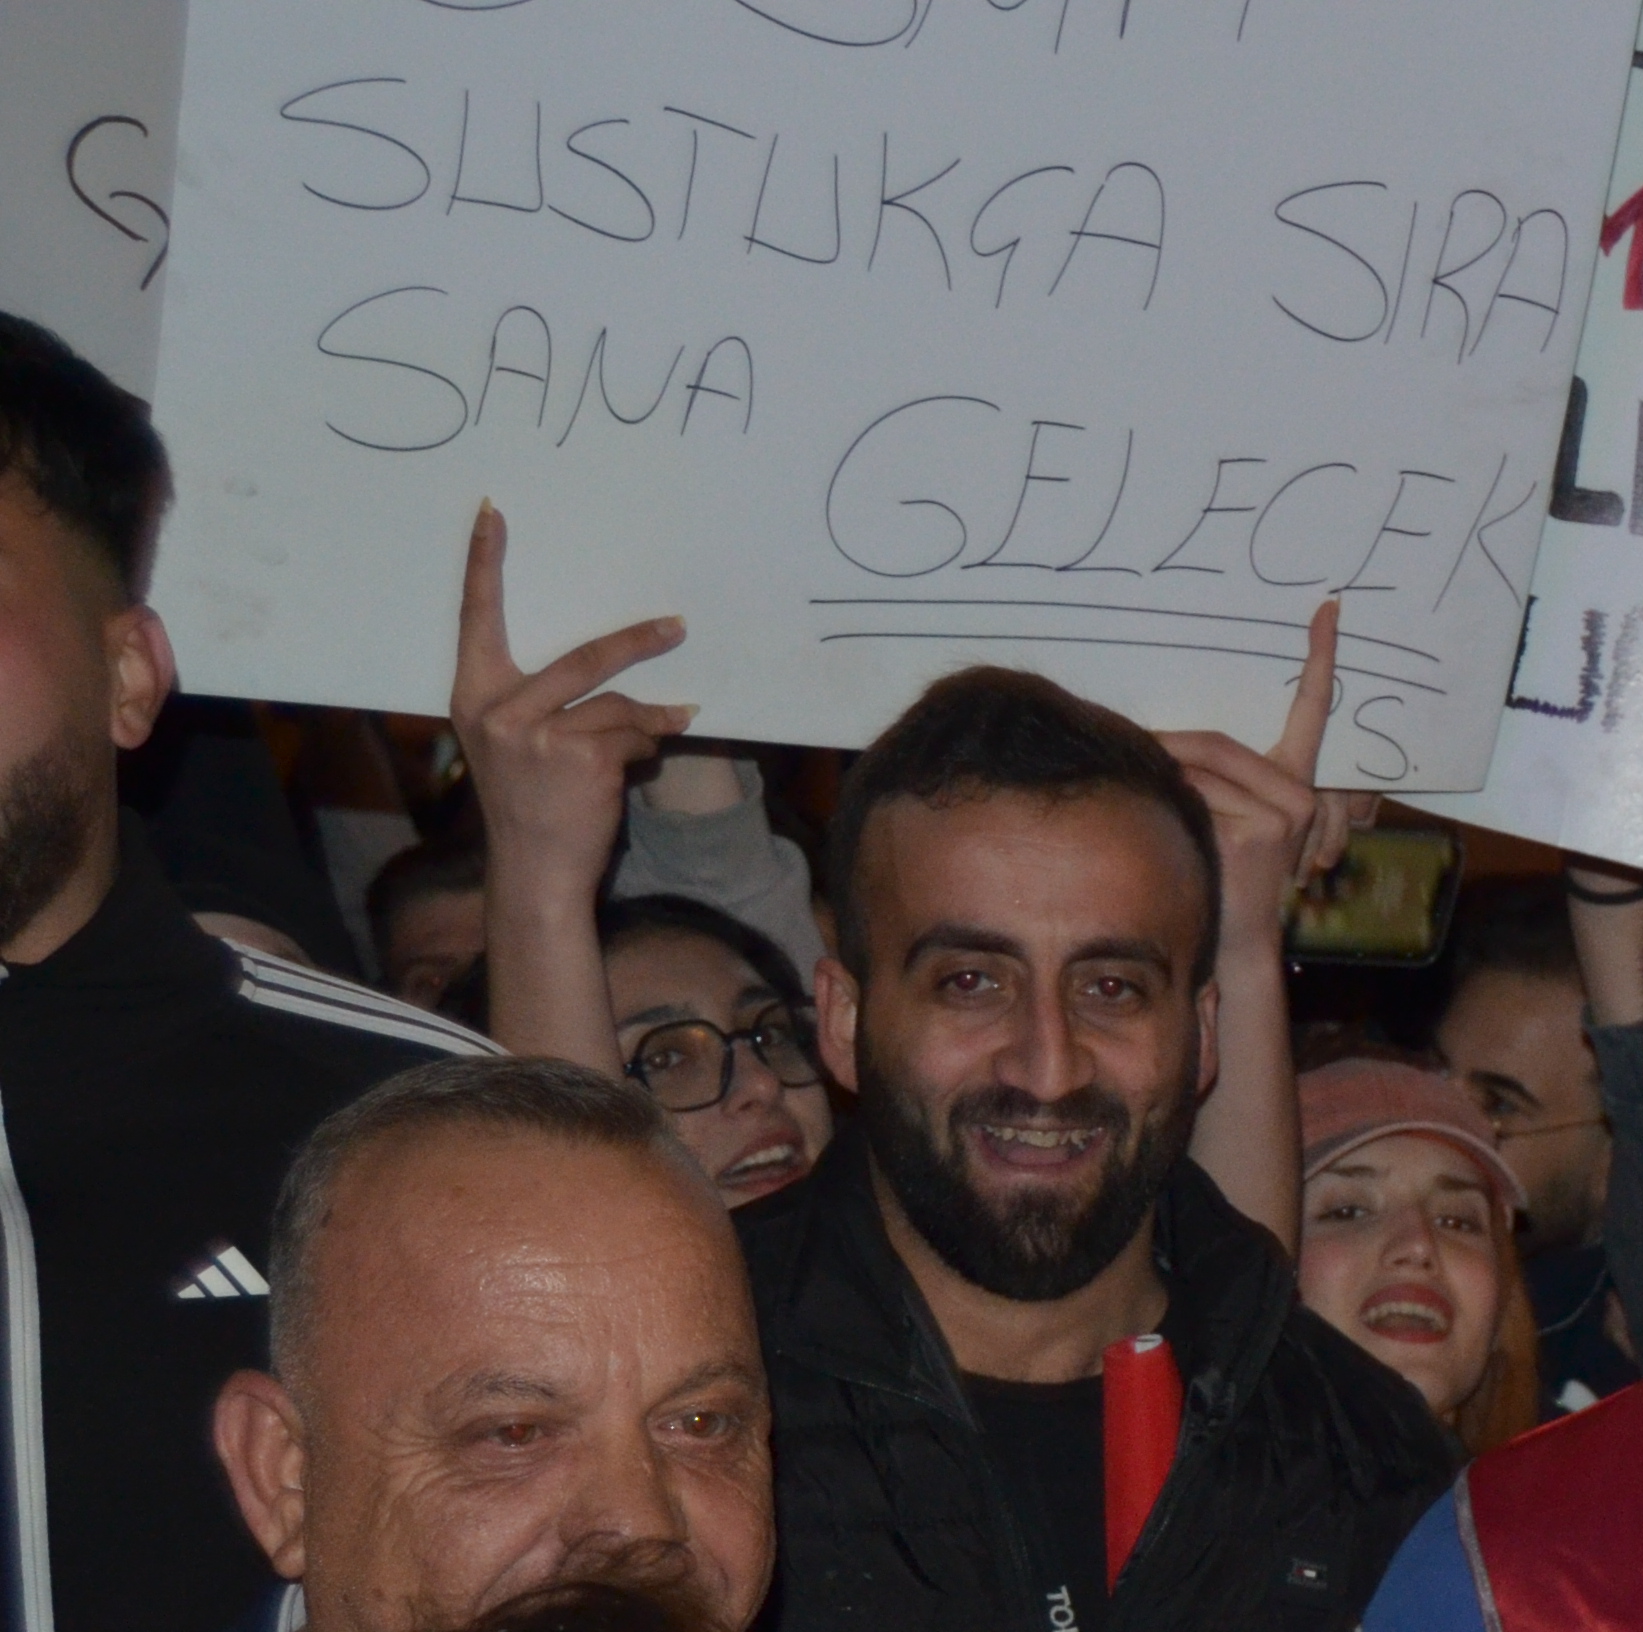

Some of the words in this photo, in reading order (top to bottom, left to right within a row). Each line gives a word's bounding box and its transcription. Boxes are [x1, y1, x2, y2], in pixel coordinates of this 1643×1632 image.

[1272, 181, 1569, 364] SIRA
[318, 286, 753, 451] SANA
[826, 396, 1537, 613] GELECEK
